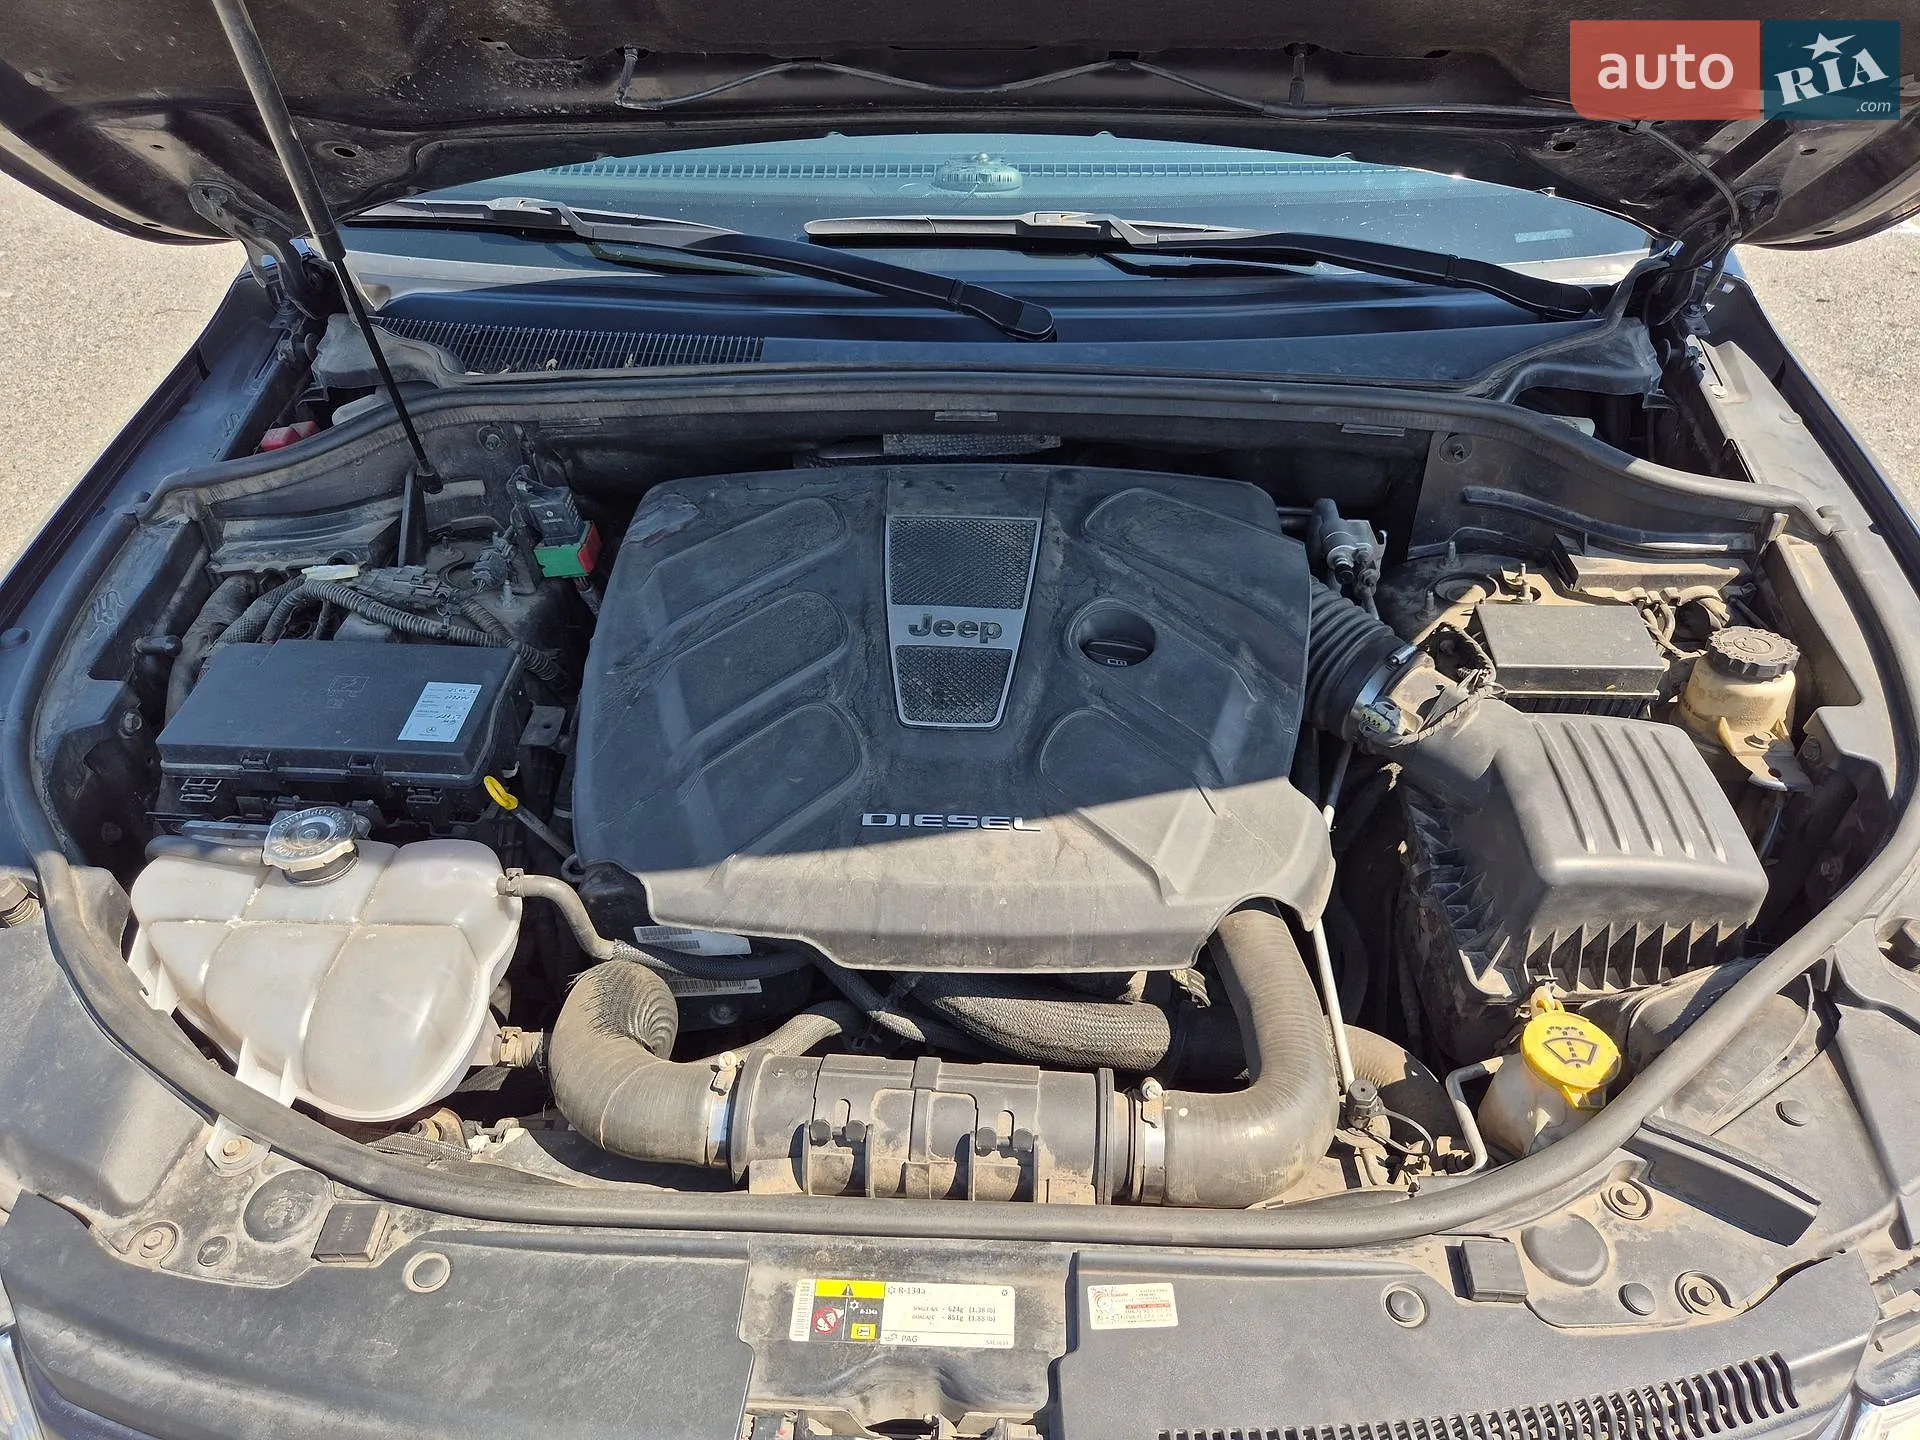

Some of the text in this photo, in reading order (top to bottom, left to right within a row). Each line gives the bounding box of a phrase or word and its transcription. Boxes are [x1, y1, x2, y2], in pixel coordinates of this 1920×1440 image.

[908, 613, 1003, 644] Jeep
[861, 812, 1042, 832] DIESEL
[898, 1286, 926, 1295] R-134a
[901, 1335, 918, 1343] PAG
